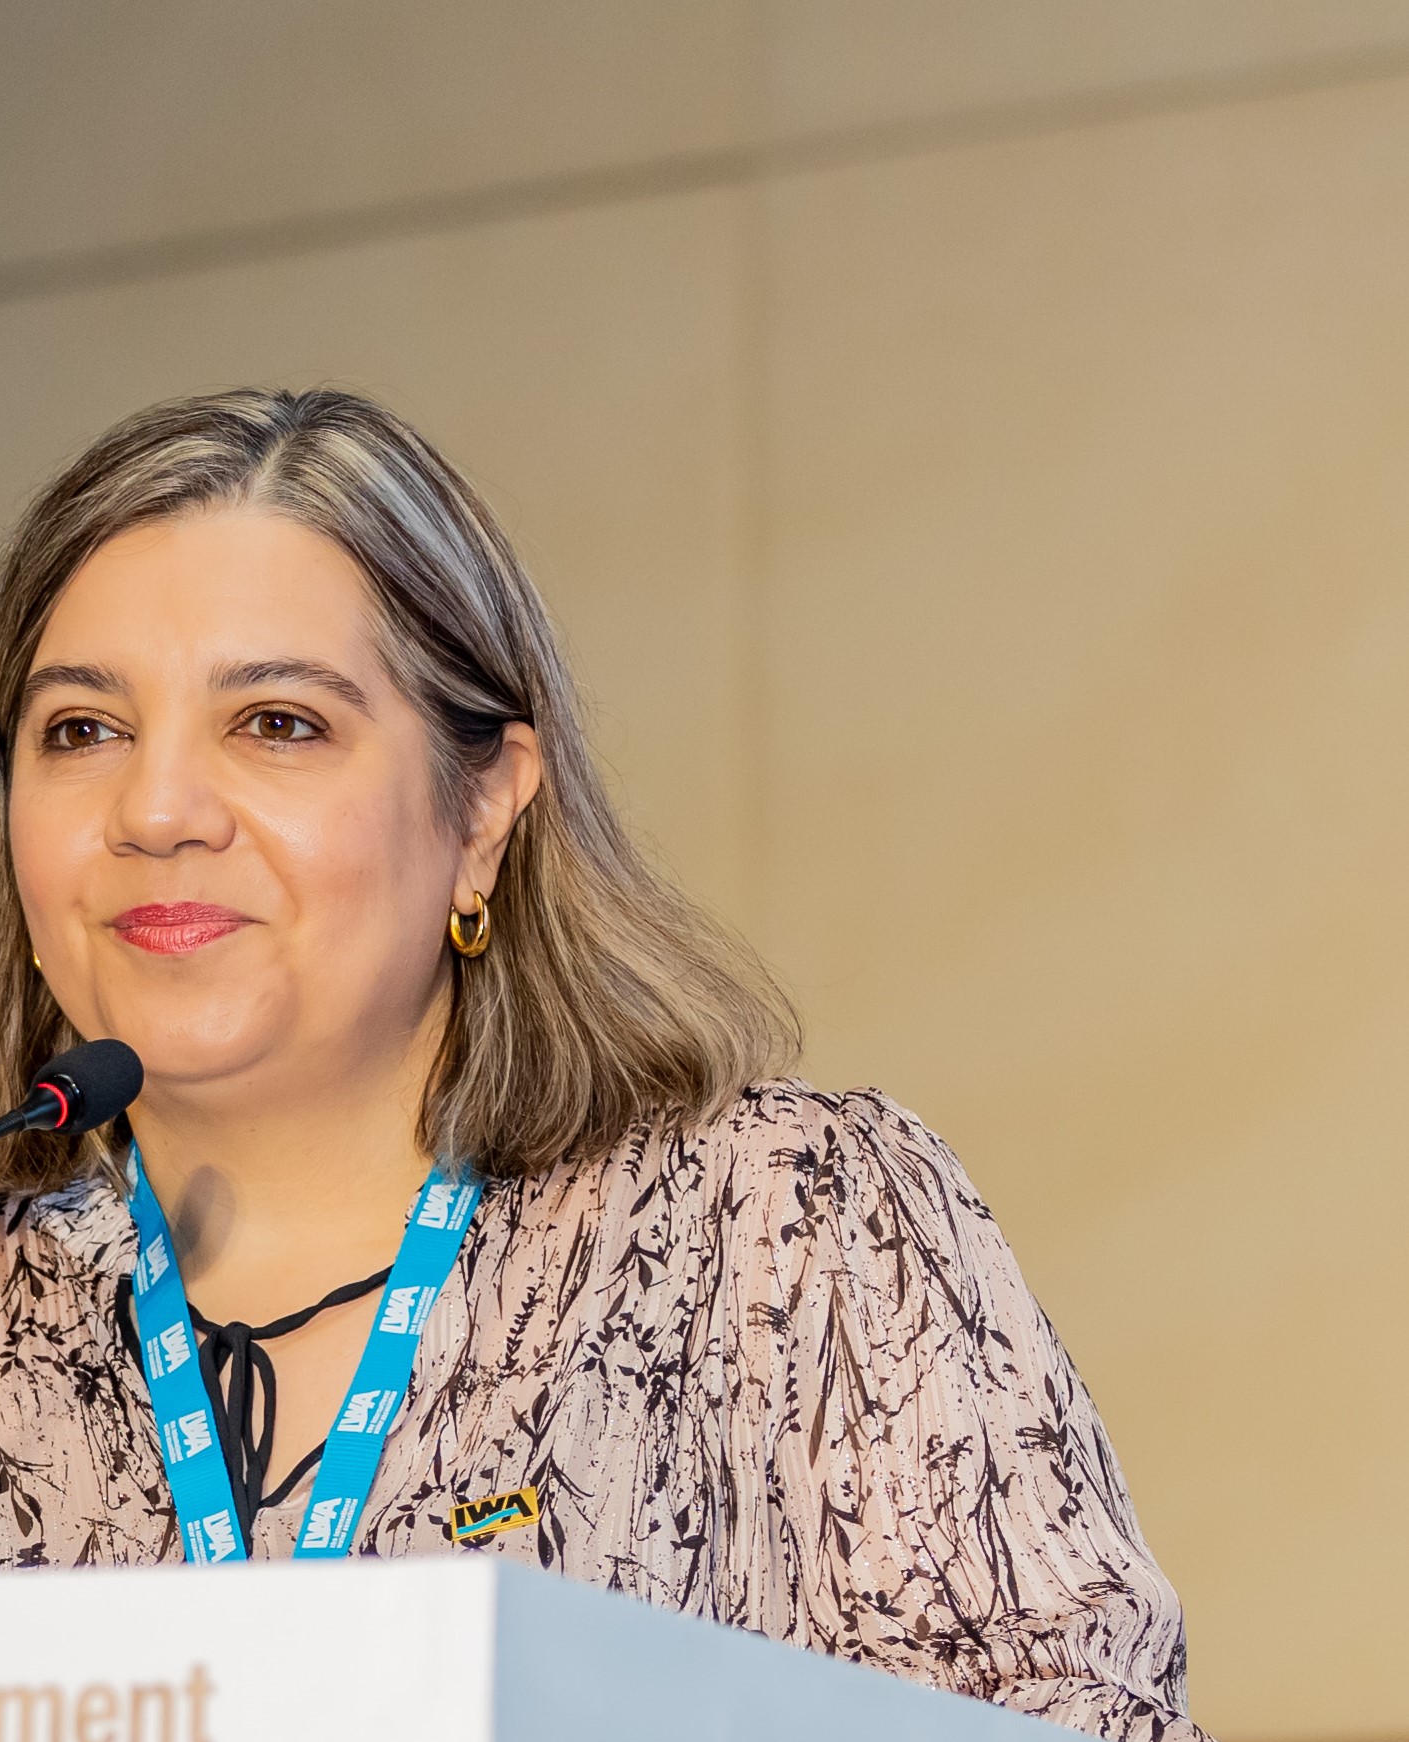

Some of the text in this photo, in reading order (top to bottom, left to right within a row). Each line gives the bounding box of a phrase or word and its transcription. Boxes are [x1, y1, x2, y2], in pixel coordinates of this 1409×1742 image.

[416, 1184, 458, 1230] IWA
[378, 1285, 421, 1335] IWA
[159, 1320, 191, 1374] IWA
[178, 1409, 212, 1459] IWA
[336, 1389, 382, 1433] IWA
[202, 1508, 237, 1564] IWA
[301, 1497, 343, 1549] IWA
[454, 1492, 534, 1535] IWA
